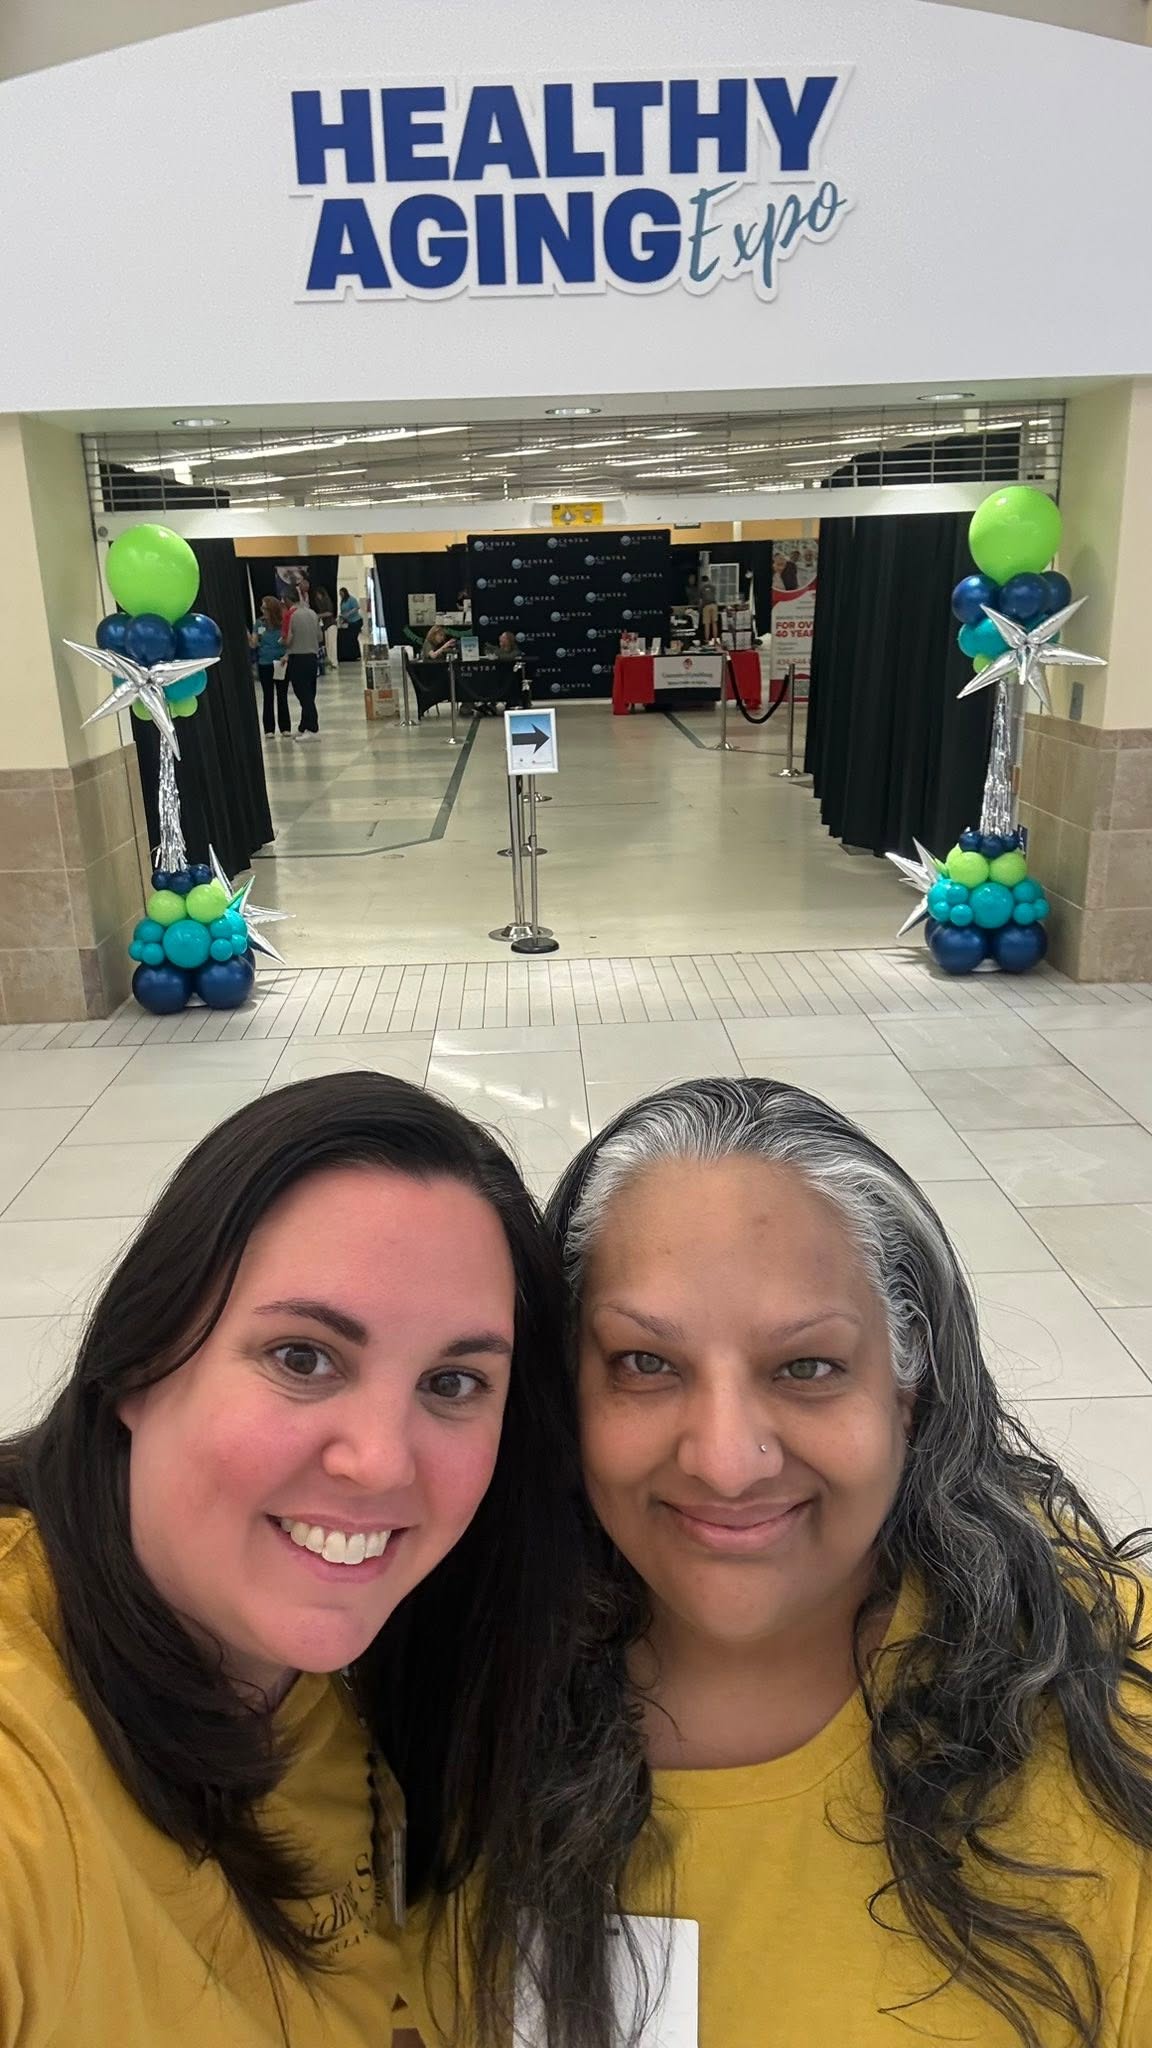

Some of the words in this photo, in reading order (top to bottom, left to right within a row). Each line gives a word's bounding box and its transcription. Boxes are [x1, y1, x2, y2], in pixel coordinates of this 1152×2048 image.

[291, 76, 838, 185] HEALTHY
[306, 188, 682, 290] AGING
[688, 180, 848, 288] Expo
[775, 630, 788, 638] 40
[790, 630, 814, 638] YEA
[776, 621, 795, 629] FOR
[798, 621, 813, 629] OV
